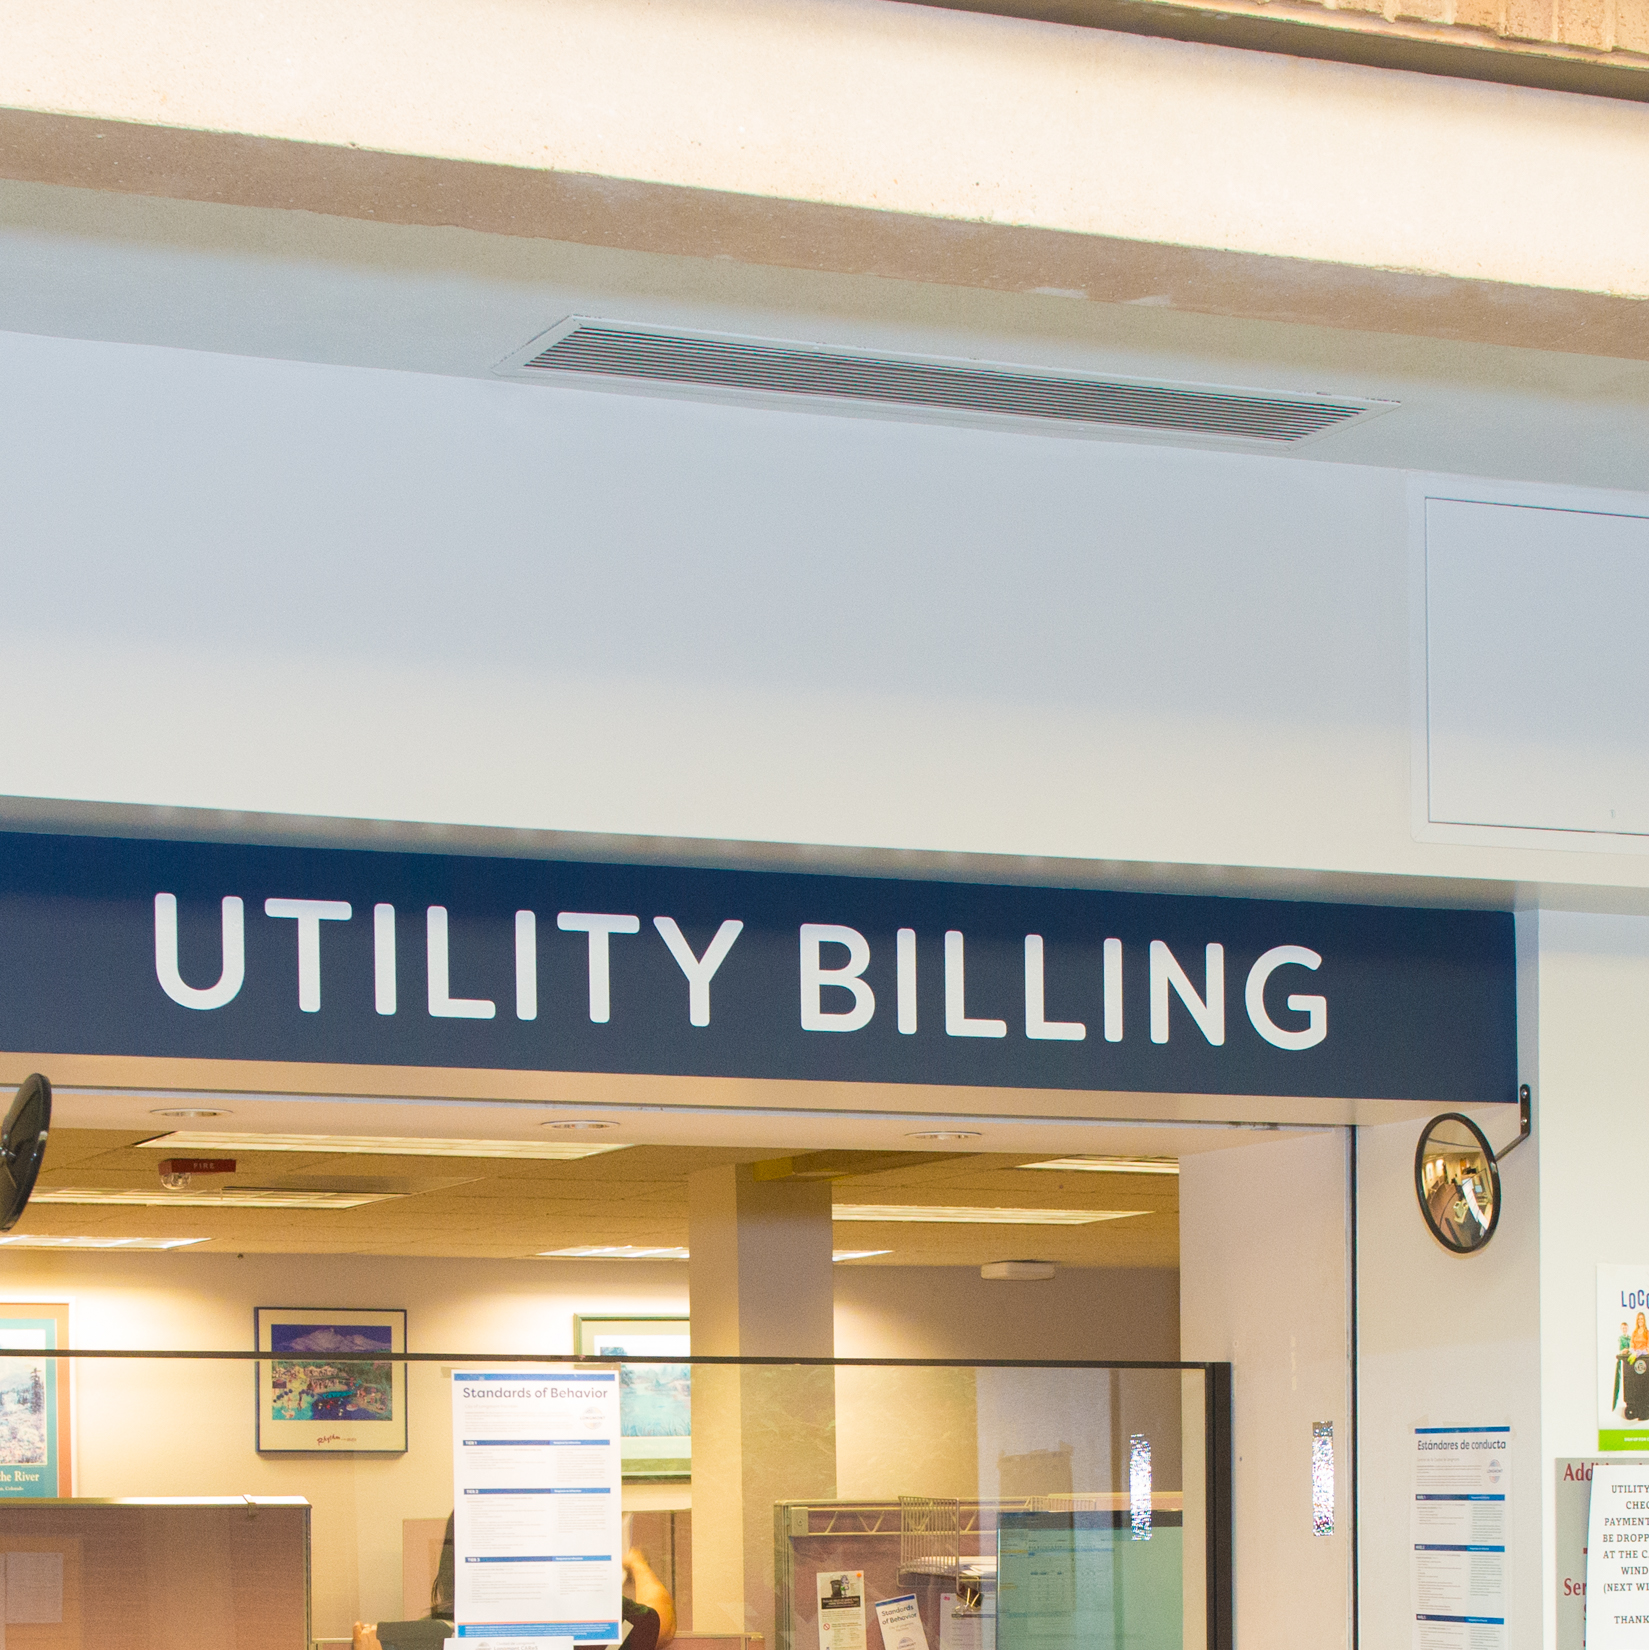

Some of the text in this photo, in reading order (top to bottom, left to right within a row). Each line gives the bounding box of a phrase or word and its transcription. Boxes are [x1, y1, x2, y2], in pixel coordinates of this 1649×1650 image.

[153, 890, 1329, 1051] UTILITY BILLING
[463, 1387, 608, 1398] Standards of Behavior
[1417, 1439, 1506, 1450] Estándares de conducta
[14, 1471, 39, 1481] River
[1611, 1485, 1649, 1493] UTILITY
[1603, 1534, 1614, 1542] BE
[1603, 1550, 1615, 1559] AT
[1619, 1550, 1638, 1558] THE
[1603, 1583, 1633, 1594] (NEXT
[1614, 1615, 1649, 1624] THANK
